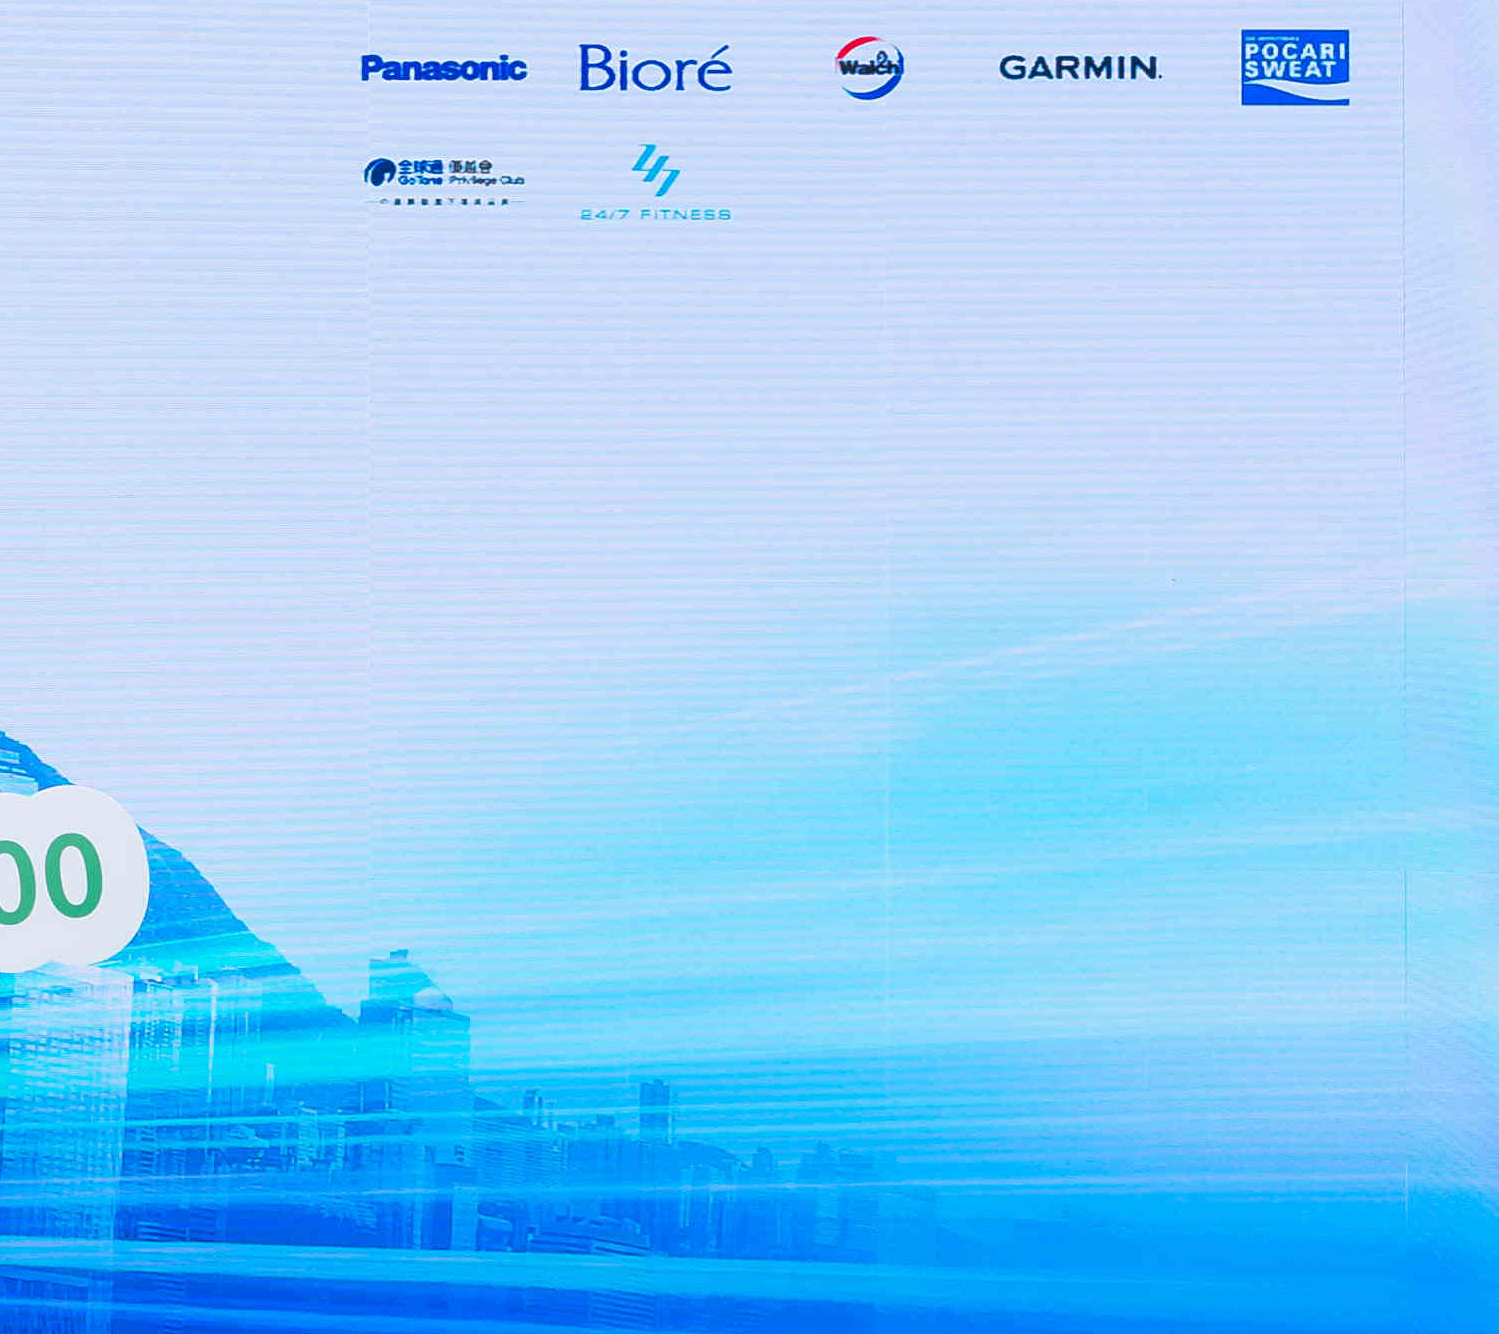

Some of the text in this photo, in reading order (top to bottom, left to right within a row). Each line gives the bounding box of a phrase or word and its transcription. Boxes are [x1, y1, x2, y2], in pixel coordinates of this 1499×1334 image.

[1245, 42, 1346, 60] POCARI
[361, 54, 528, 82] Panasonic
[579, 43, 733, 92] Bioré
[1245, 60, 1338, 79] SWEAT
[639, 208, 732, 221] FITNESS
